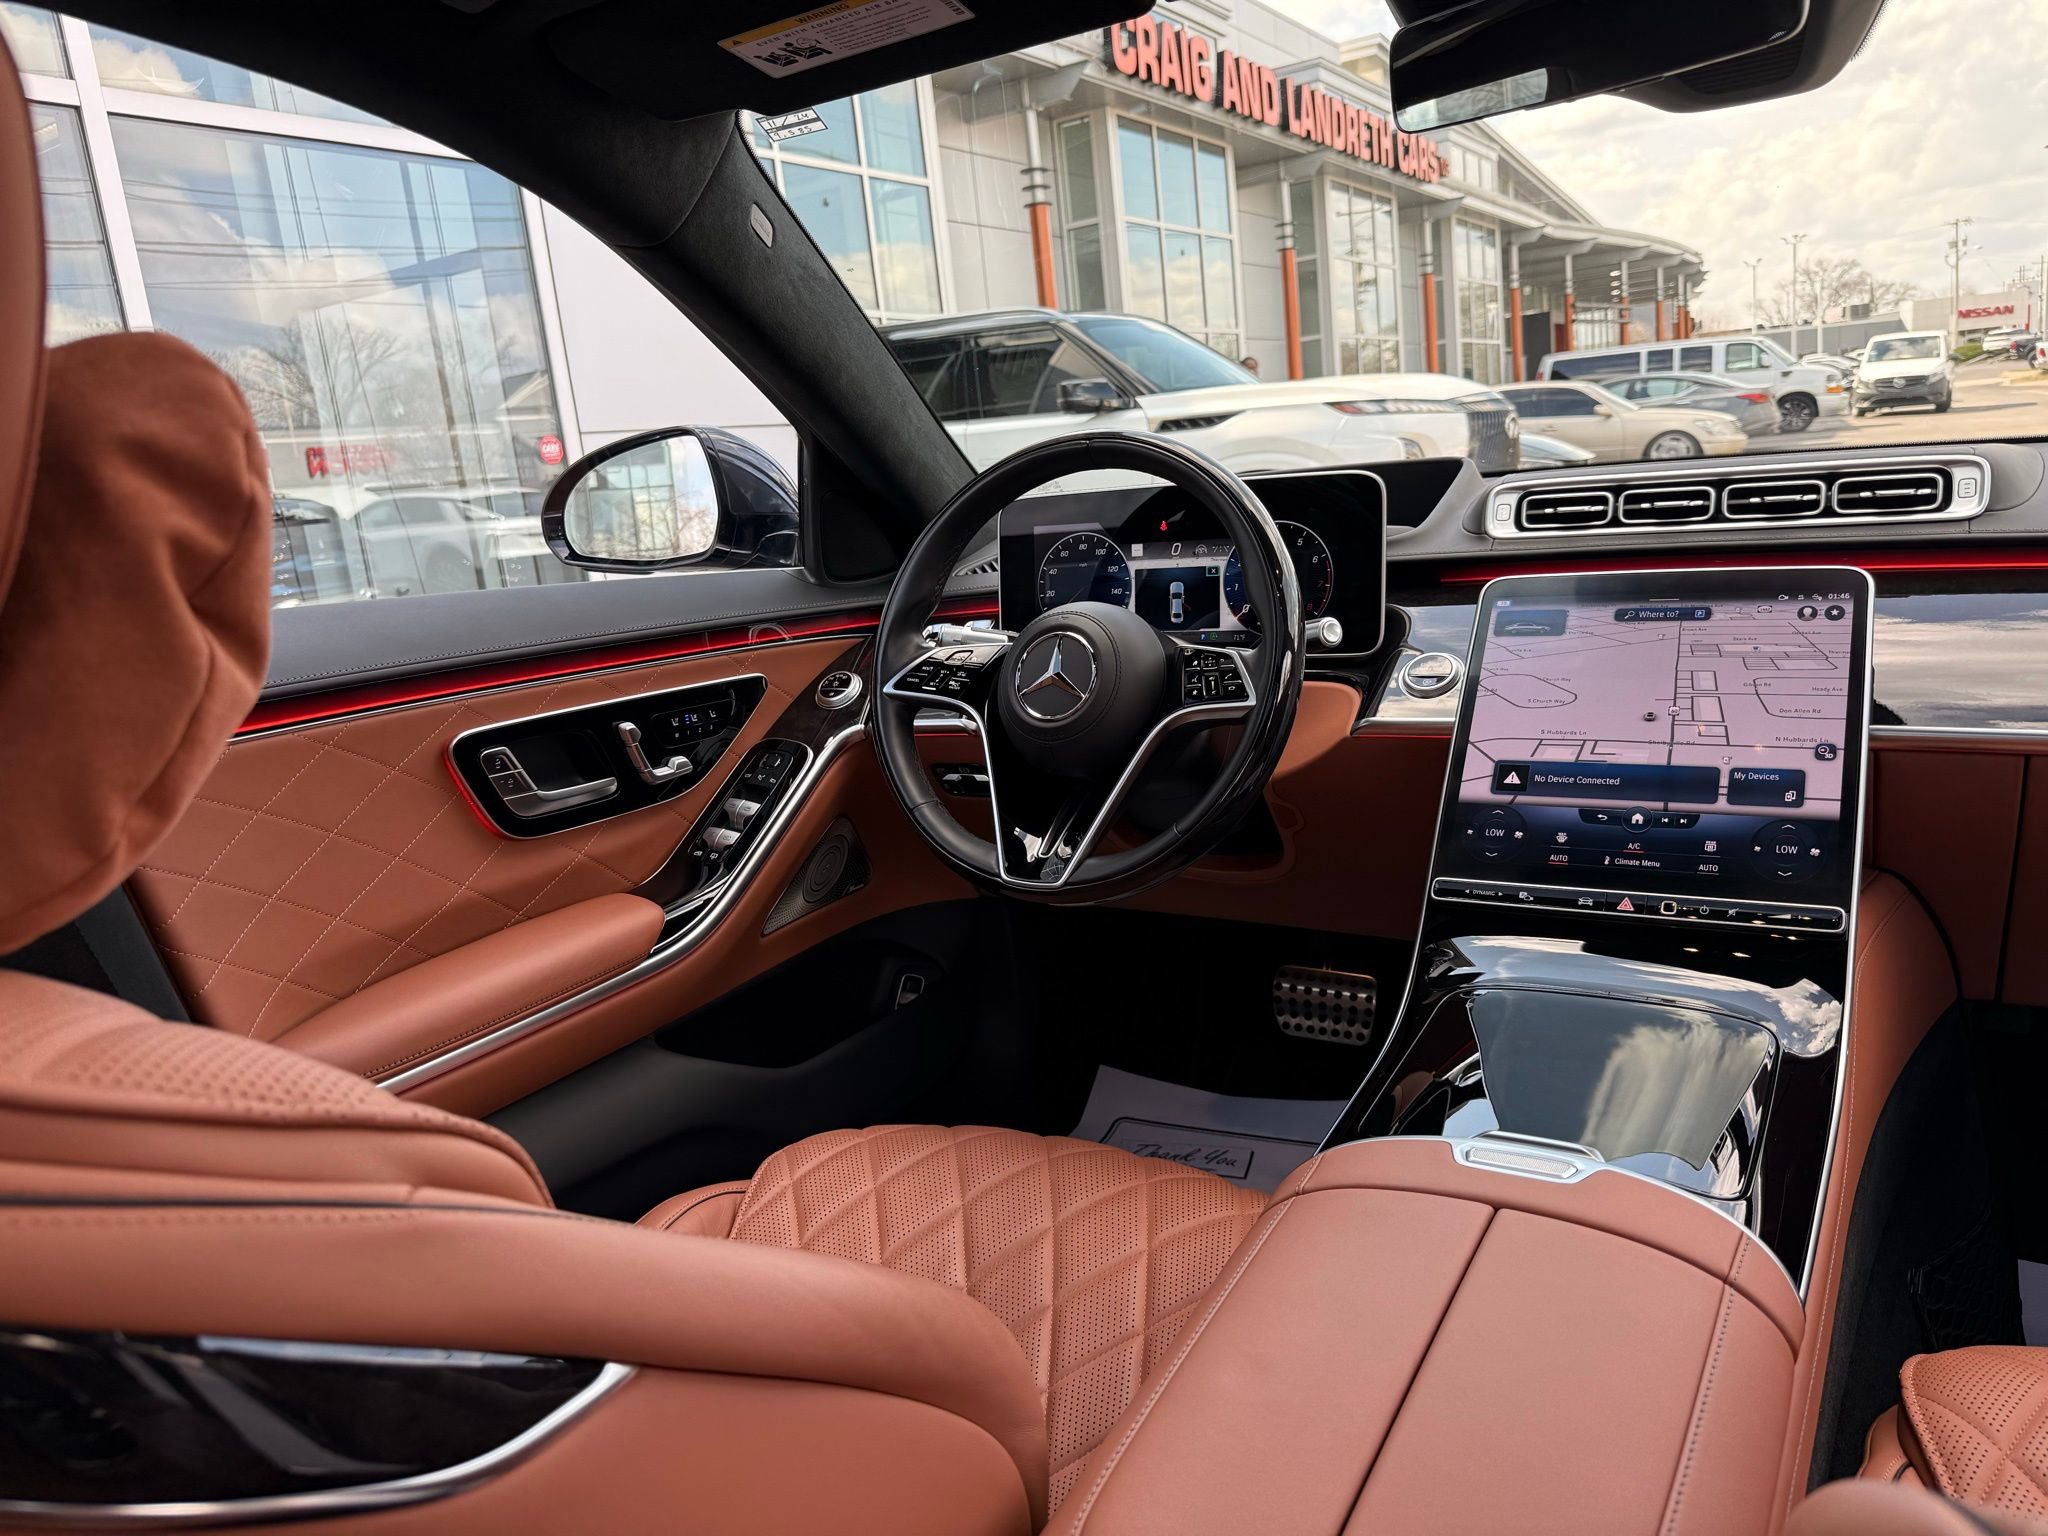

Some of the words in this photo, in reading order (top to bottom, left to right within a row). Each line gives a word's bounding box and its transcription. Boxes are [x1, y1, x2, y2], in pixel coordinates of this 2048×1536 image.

[794, 2, 850, 24] WARNING
[1111, 13, 1213, 103] CRAIG
[1223, 49, 1281, 127] AND
[1286, 77, 1395, 169] LANDRETH
[1397, 132, 1441, 184] CARS
[1957, 304, 2015, 319] NISSAN
[1296, 537, 1304, 546] 5
[1095, 548, 1107, 556] 100
[1312, 555, 1319, 563] 6
[1107, 565, 1119, 573] 120
[1638, 610, 1665, 618] Where
[1666, 610, 1680, 618] to?
[1534, 774, 1546, 782] No
[1547, 775, 1575, 784] Device
[1576, 776, 1620, 785] Connected
[1733, 771, 1746, 781] My
[1748, 772, 1780, 781] Devices
[1485, 828, 1505, 837] LOW
[1627, 842, 1641, 850] A/C
[1775, 845, 1799, 855] LOW
[1549, 854, 1569, 862] AUTO
[1614, 857, 1641, 866] Climate
[1641, 859, 1661, 867] Menu
[1698, 863, 1719, 872] AUTO
[1472, 889, 1496, 897] DYNAMIC
[1133, 1144, 1201, 1162] Thank
[1203, 1149, 1237, 1168] You
